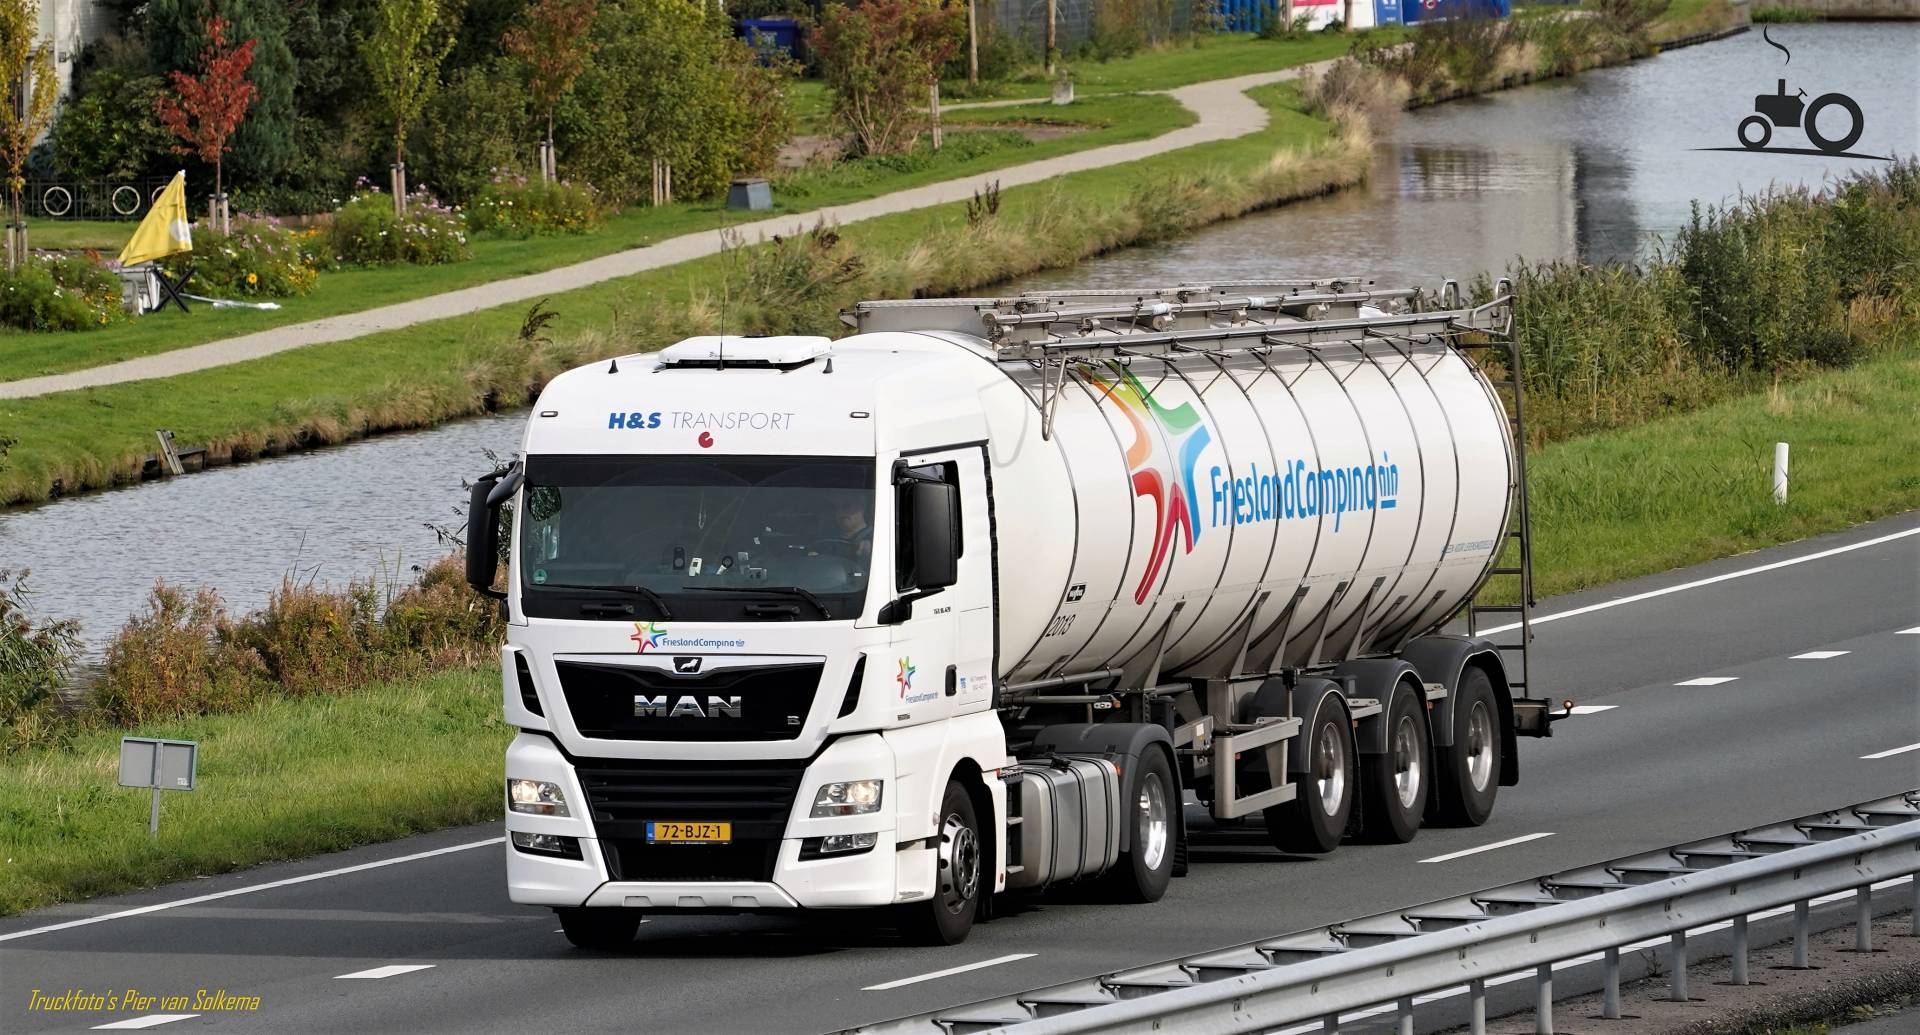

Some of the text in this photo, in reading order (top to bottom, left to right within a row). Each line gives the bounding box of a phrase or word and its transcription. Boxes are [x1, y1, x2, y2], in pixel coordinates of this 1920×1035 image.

[608, 411, 795, 430] H&S TRANSPORT
[1210, 459, 1376, 533] FrieslandCampina
[1045, 614, 1076, 637] 2013
[662, 638, 735, 648] FrieslandCampina
[634, 695, 742, 718] MAN
[662, 825, 721, 838] 72-BJZ-1
